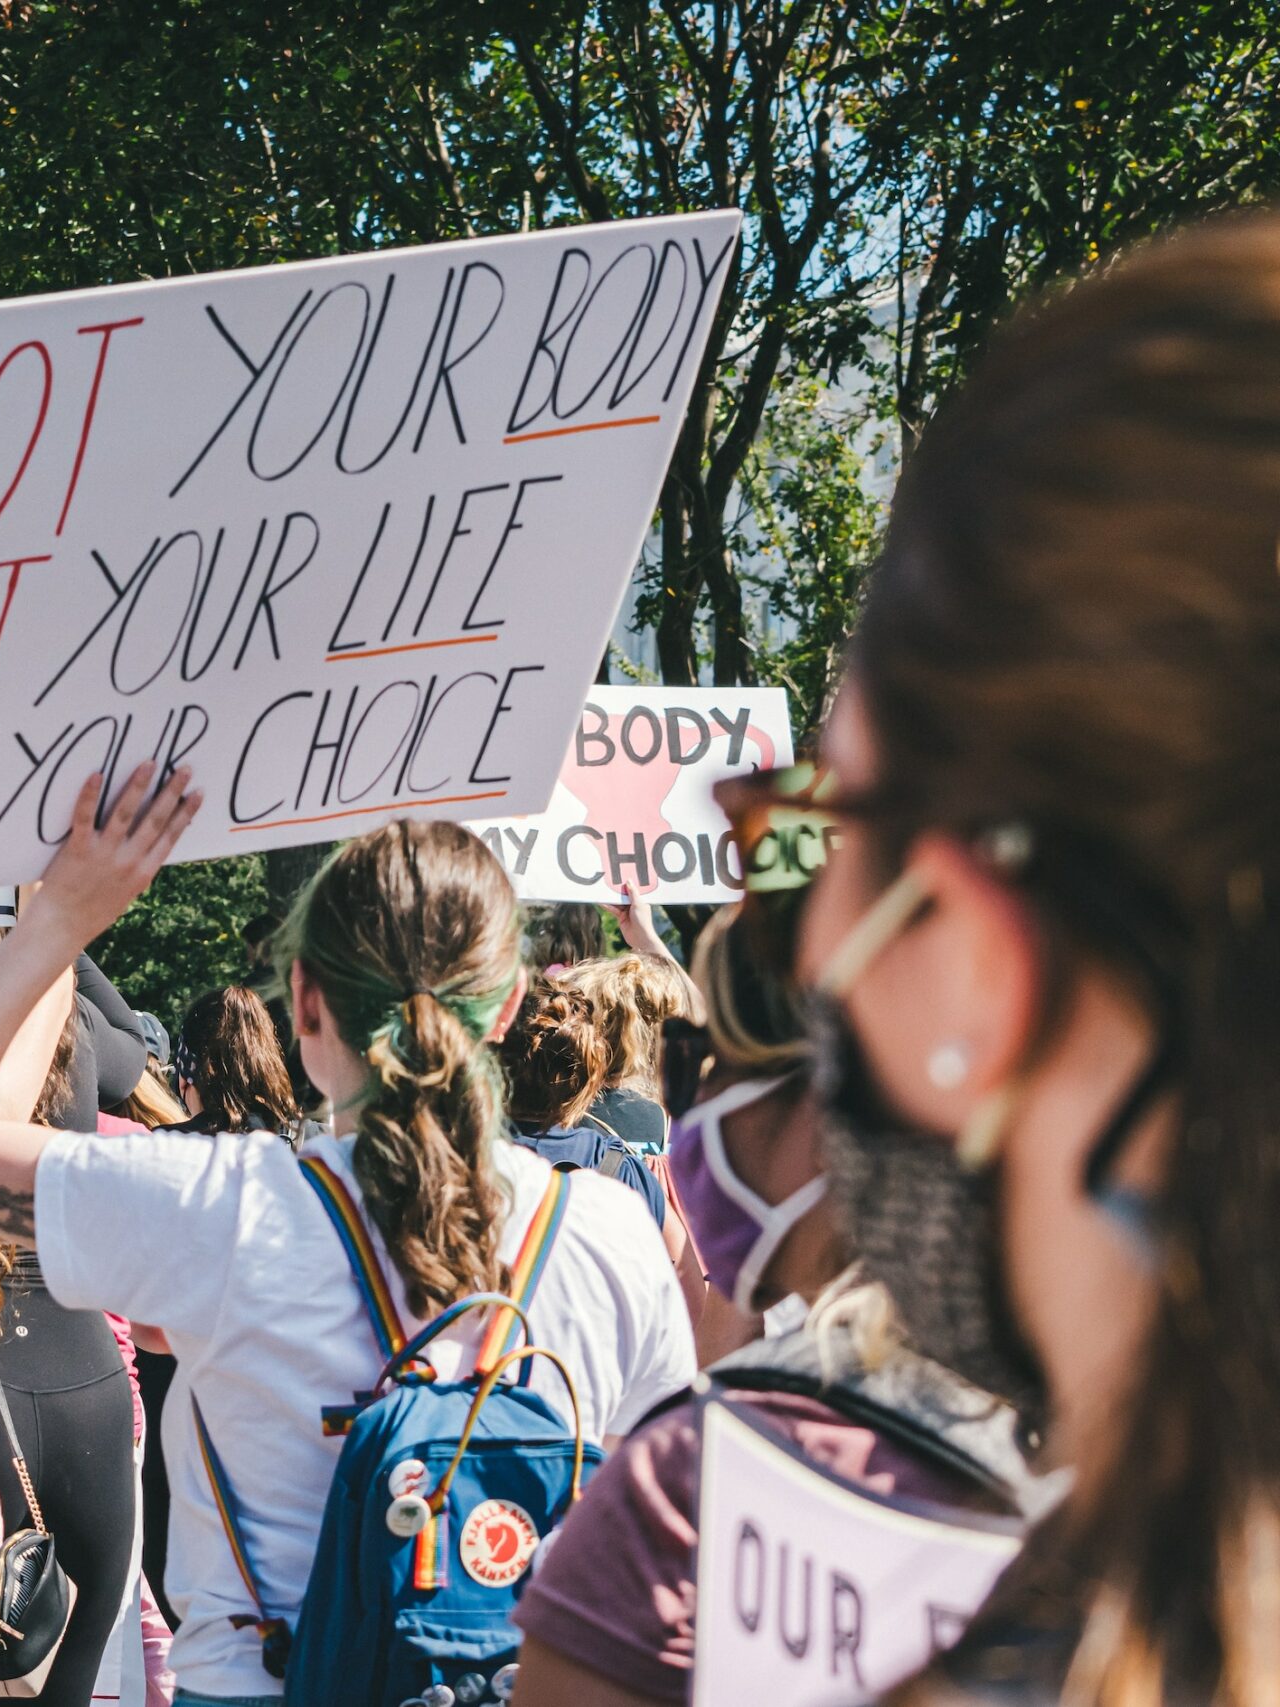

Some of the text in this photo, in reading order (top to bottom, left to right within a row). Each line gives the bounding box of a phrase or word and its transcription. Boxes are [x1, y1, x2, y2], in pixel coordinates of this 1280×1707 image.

[169, 260, 505, 499] YOUR
[506, 234, 737, 435] BODY
[33, 510, 320, 707] YOUR
[327, 474, 564, 653] LIFE
[228, 664, 546, 824] CHOICE
[575, 702, 751, 767] BODY
[556, 823, 746, 891] CHOIC
[733, 1517, 867, 1692] OUR
